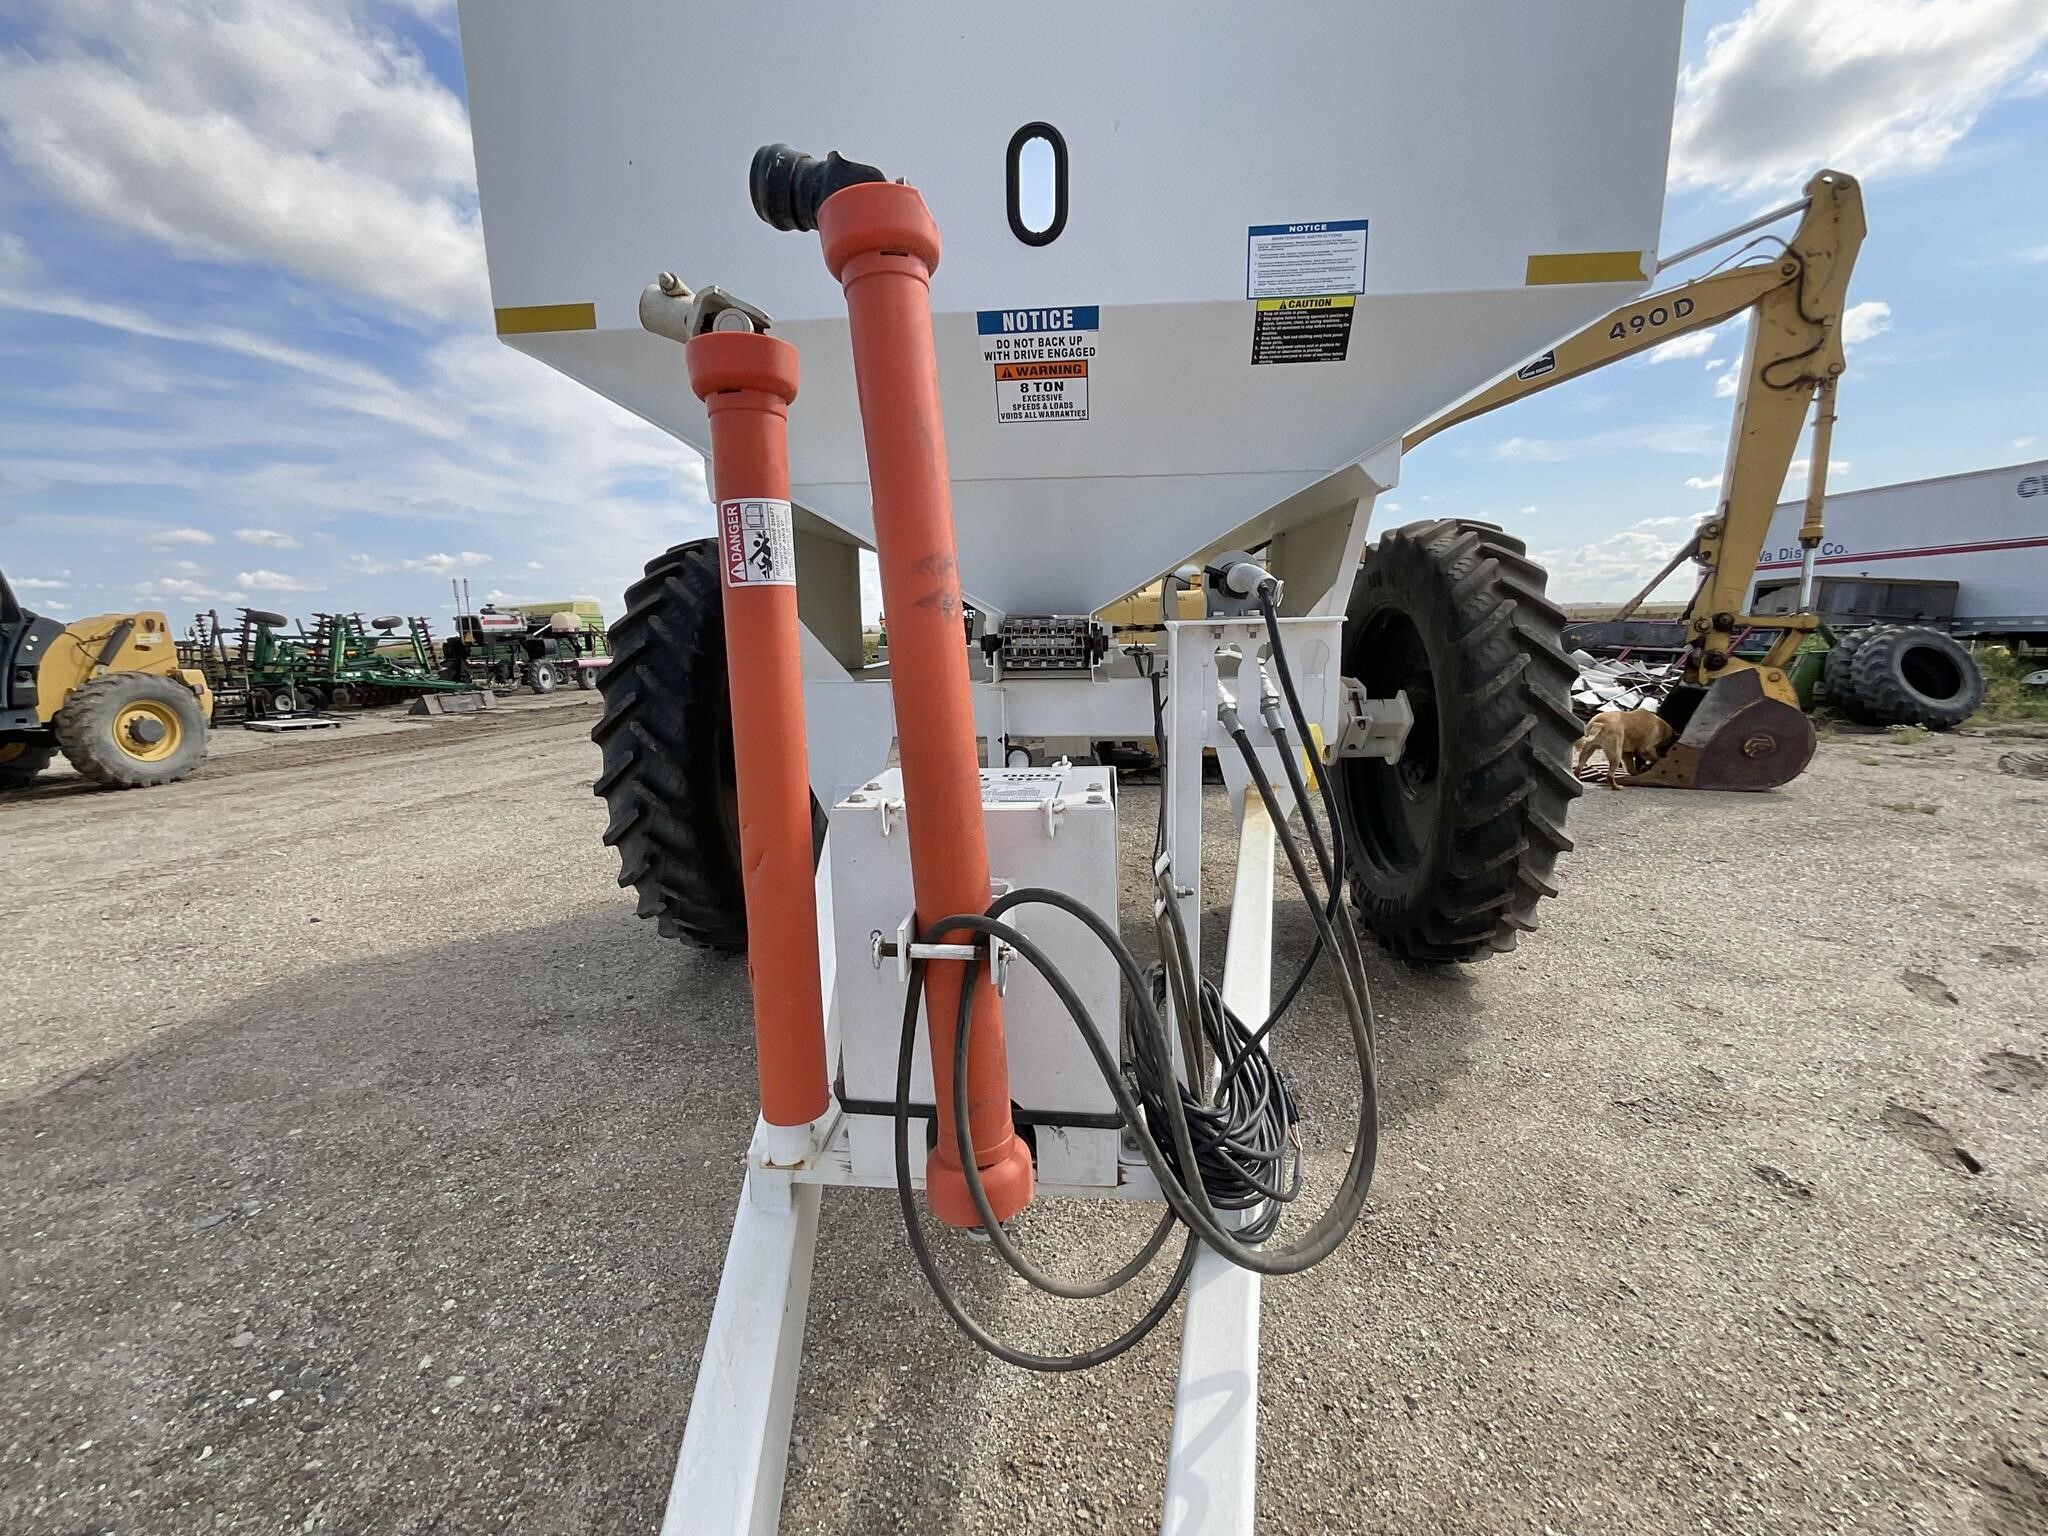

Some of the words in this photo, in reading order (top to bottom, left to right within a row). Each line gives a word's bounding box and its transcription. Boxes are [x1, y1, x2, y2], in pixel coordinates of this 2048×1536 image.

[1289, 224, 1328, 232] NOTICE
[1288, 298, 1332, 308] CAUTION
[1002, 309, 1074, 332] NOTICE
[996, 339, 1010, 349] DO
[1014, 338, 1035, 349] NOT
[1038, 336, 1066, 348] BACK
[1069, 336, 1083, 346] UP
[984, 350, 1010, 361] WITH
[1014, 349, 1044, 360] DRIVE
[1048, 347, 1096, 359] ENGAGED
[1016, 364, 1082, 377] WARNING
[1020, 382, 1030, 393] 8
[1033, 381, 1064, 392] TON
[1022, 394, 1063, 403] EXCESSIVE
[1012, 402, 1040, 411] SPEEDS
[1042, 402, 1048, 410] &
[1050, 401, 1074, 410] LOADS
[1000, 412, 1022, 420] VOIDS
[1024, 411, 1038, 420] ALL
[1038, 409, 1086, 419] WARRANTIES
[726, 506, 742, 562] DANGER
[1822, 542, 1848, 556] Co.
